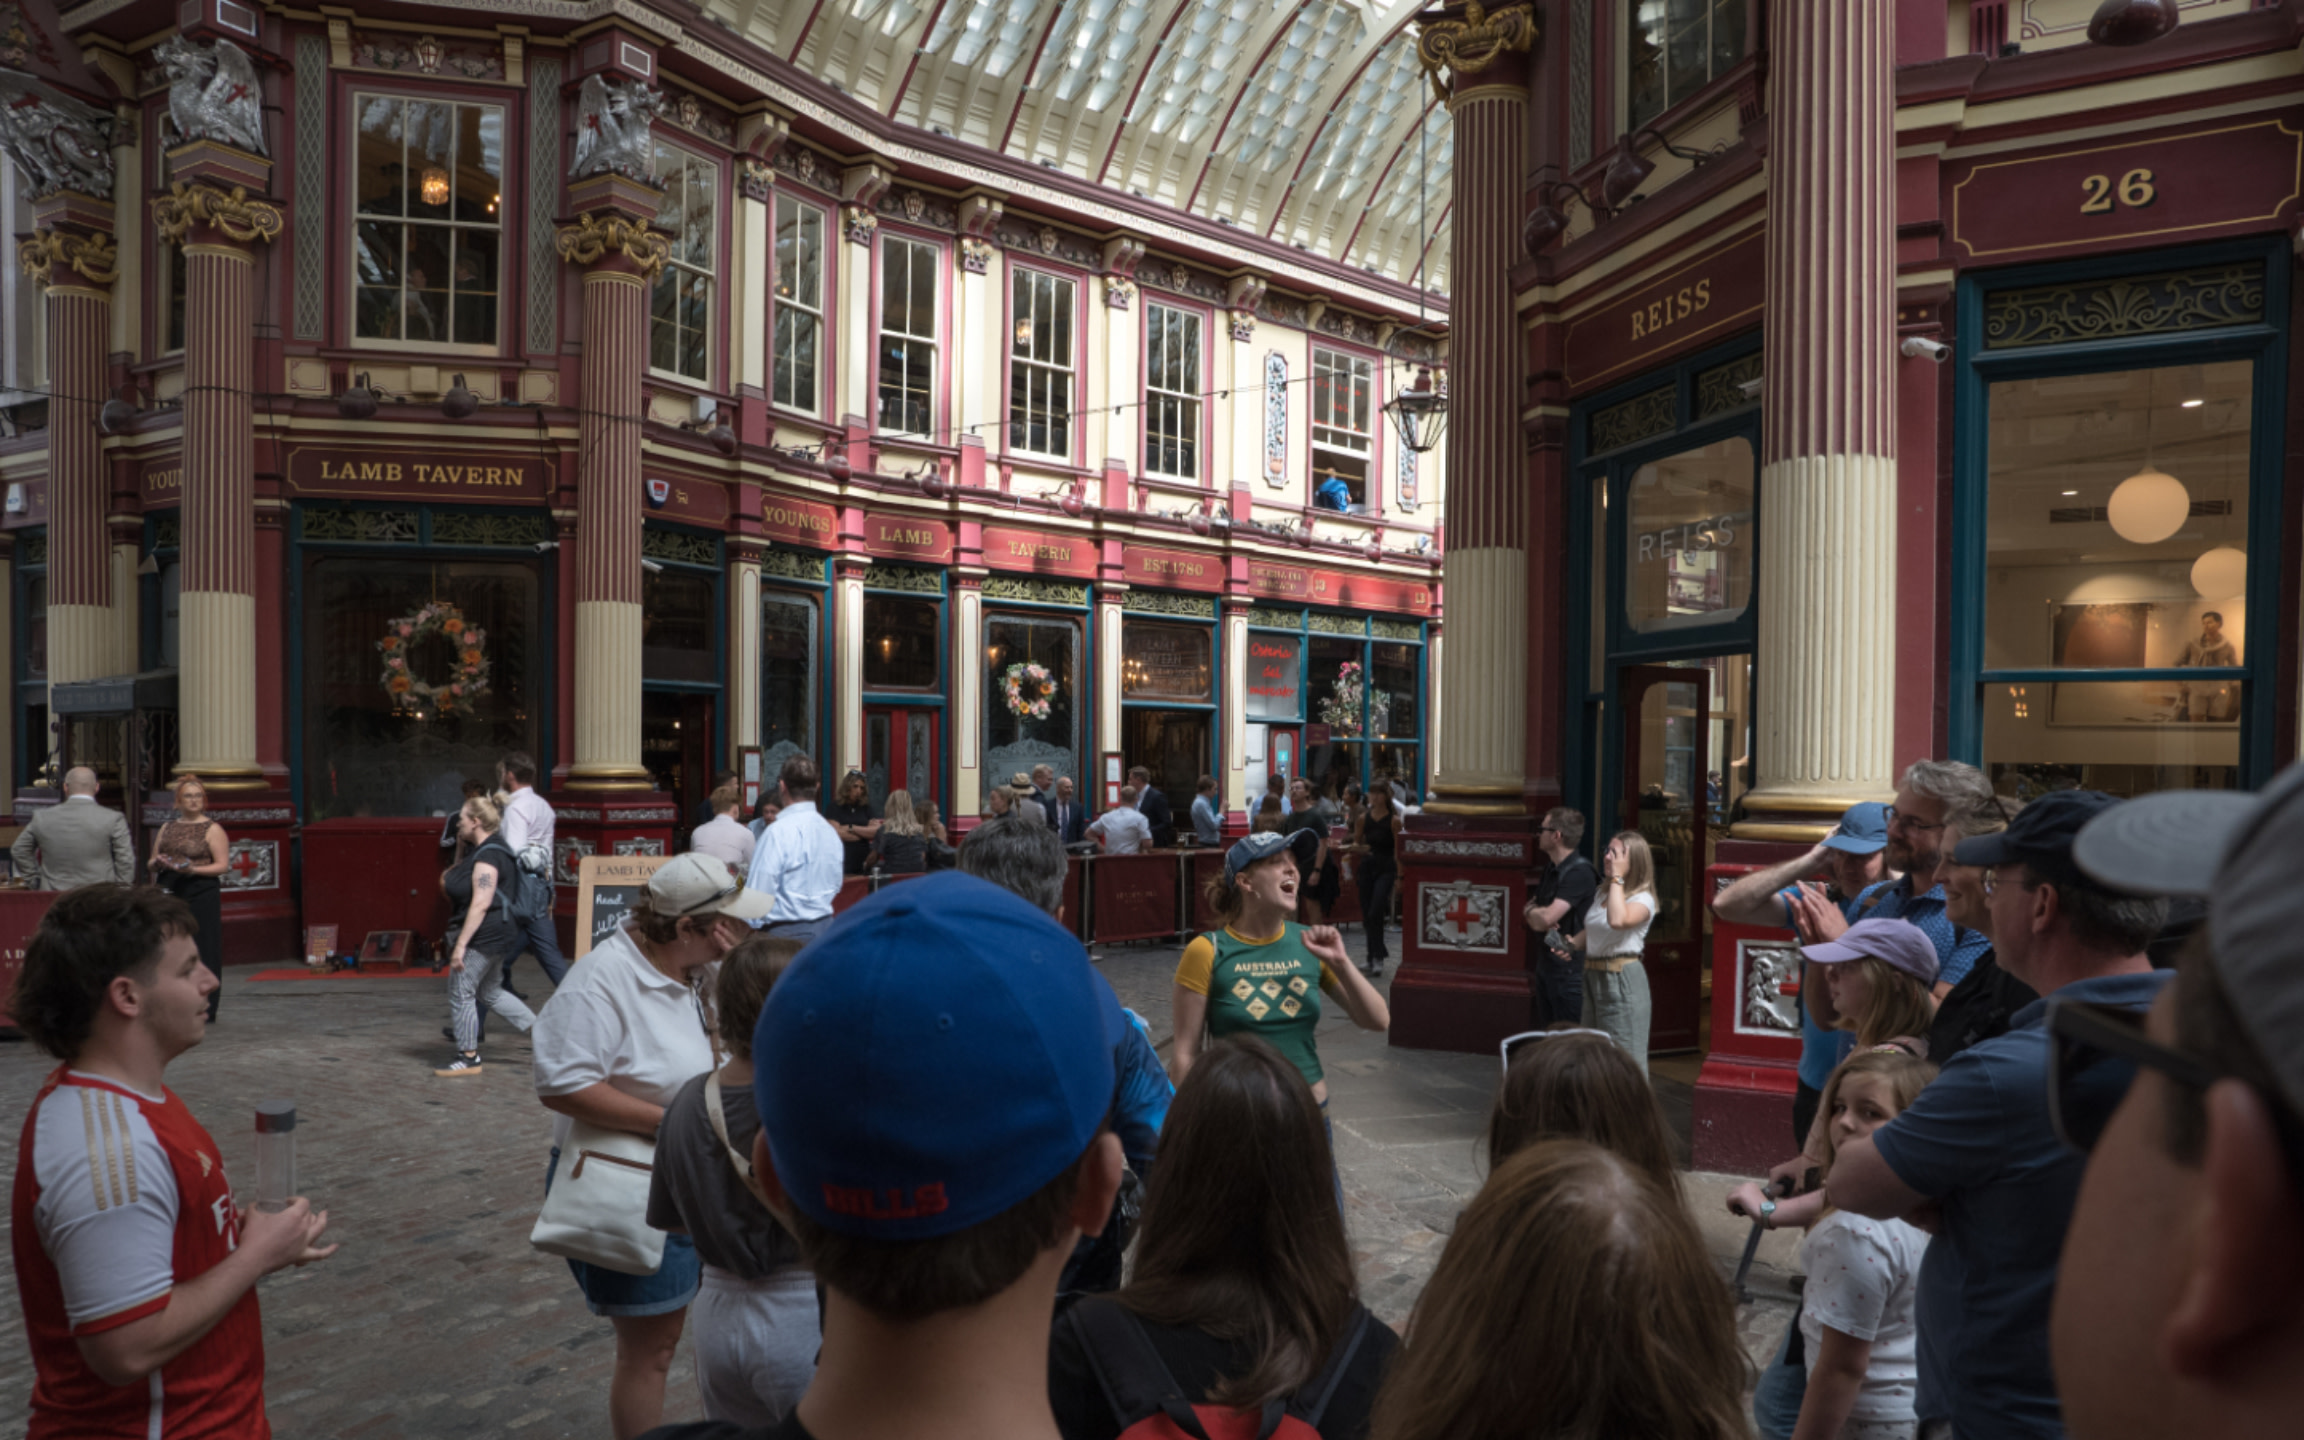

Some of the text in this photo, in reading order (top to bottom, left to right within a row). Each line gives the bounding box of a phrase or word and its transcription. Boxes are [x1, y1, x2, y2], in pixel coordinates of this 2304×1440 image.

[2080, 168, 2156, 214] 26
[1631, 277, 1711, 341] REISS
[321, 459, 525, 487] LAMB TAVERN
[880, 526, 934, 546] LAMB
[1638, 515, 1735, 563] REISS
[1008, 541, 1072, 562] TAVERN
[1262, 664, 1283, 679] del
[597, 866, 633, 876] LAMB
[1234, 959, 1302, 973] AUSTRALIA
[821, 1180, 950, 1220] BILLS
